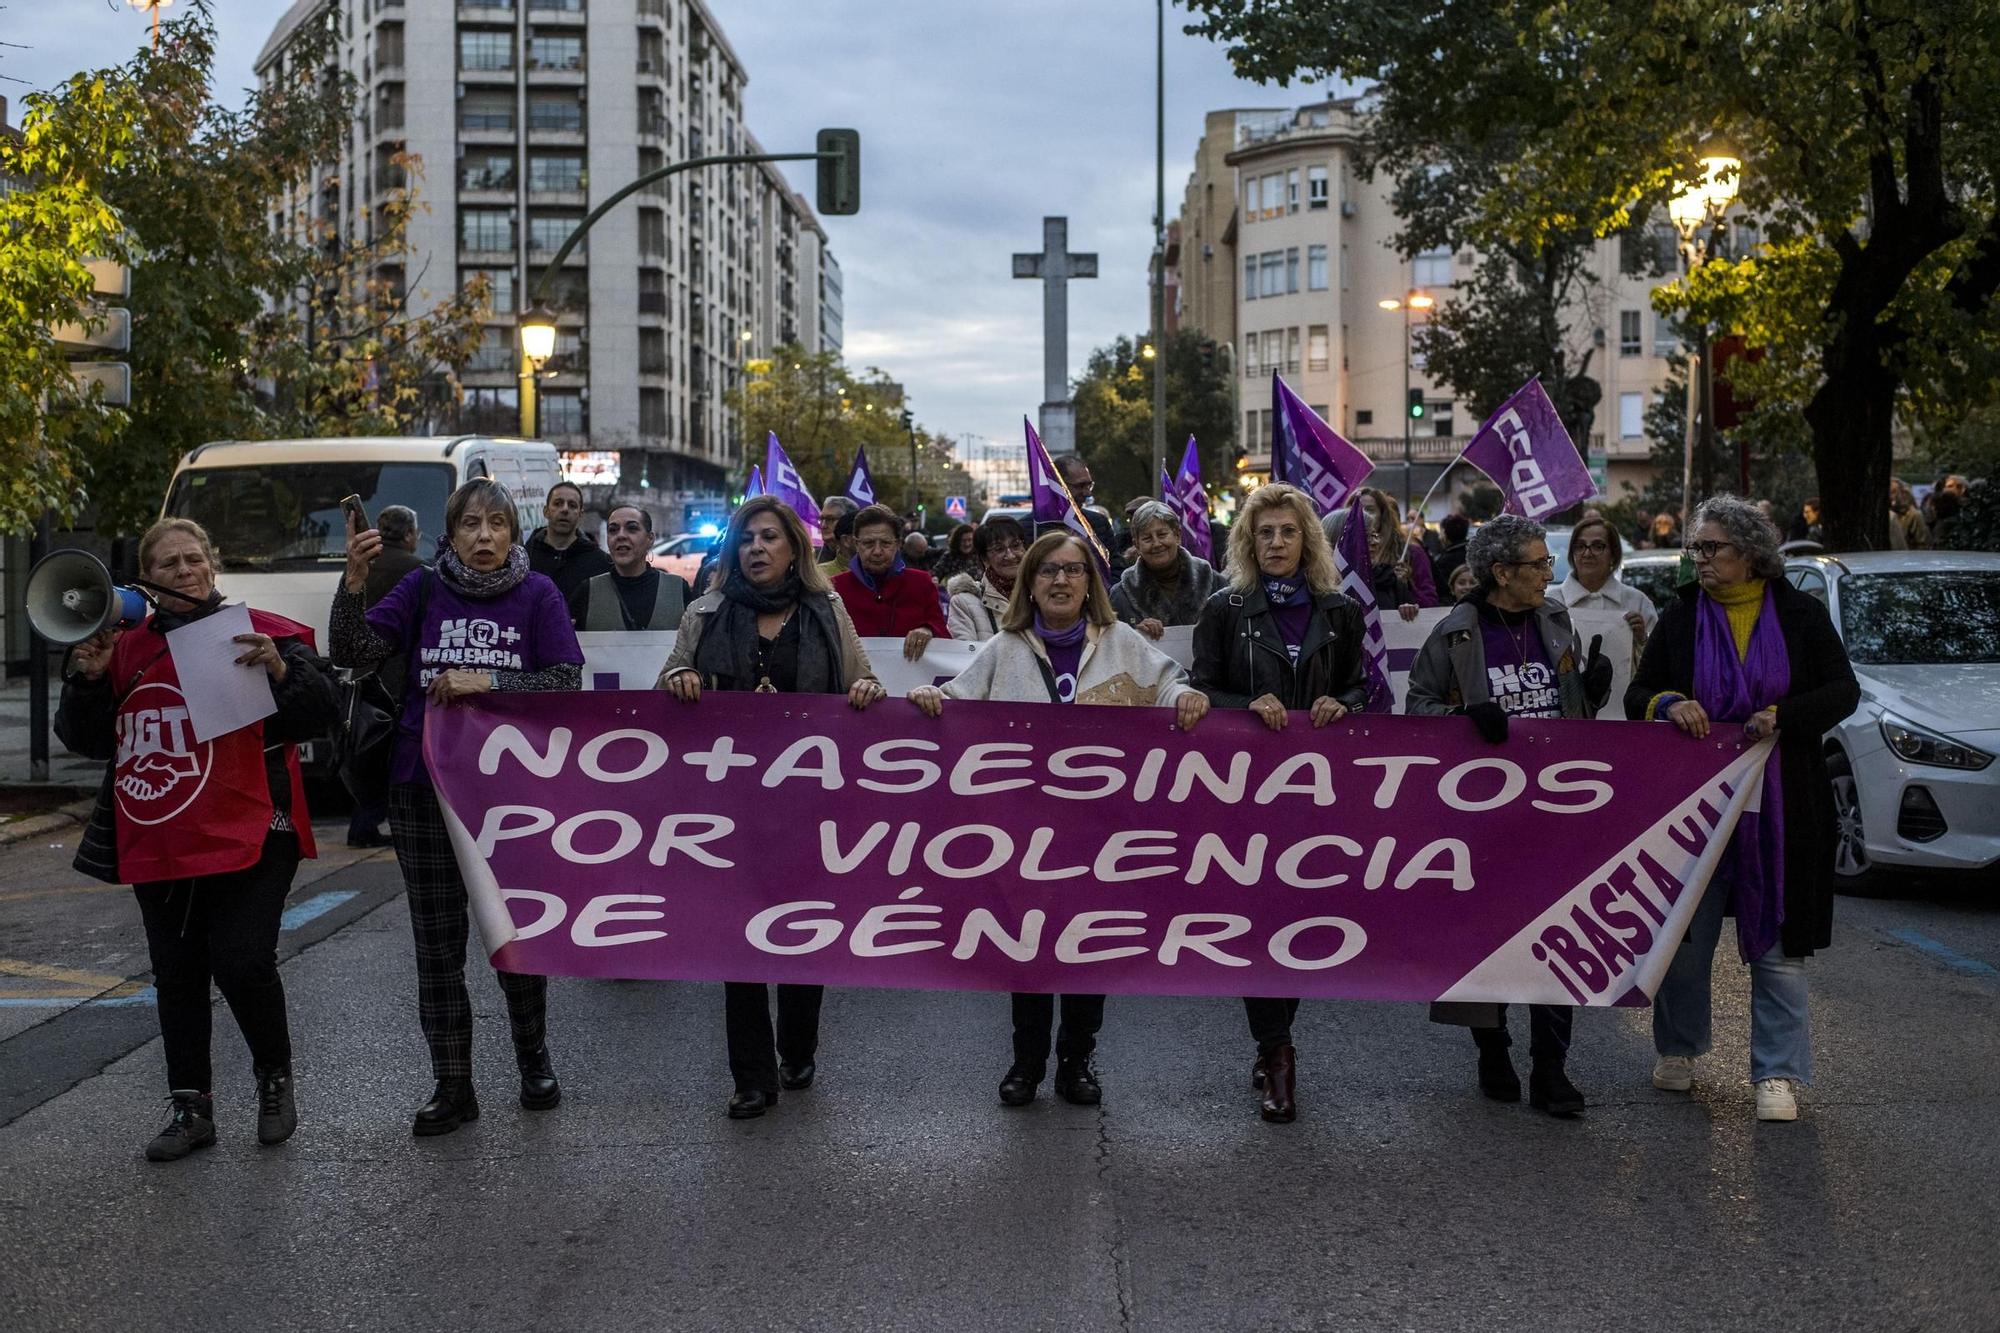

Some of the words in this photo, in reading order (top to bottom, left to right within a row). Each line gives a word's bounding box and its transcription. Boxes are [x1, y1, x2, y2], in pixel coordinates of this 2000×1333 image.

[1491, 407, 1558, 518] CCOO
[420, 647, 522, 670] VIOLENCIA
[116, 705, 190, 768] UGT
[476, 805, 735, 868] POR
[820, 820, 1475, 891] VIOLENCIA
[500, 889, 668, 948] DE
[745, 887, 1368, 971] GÉNERO
